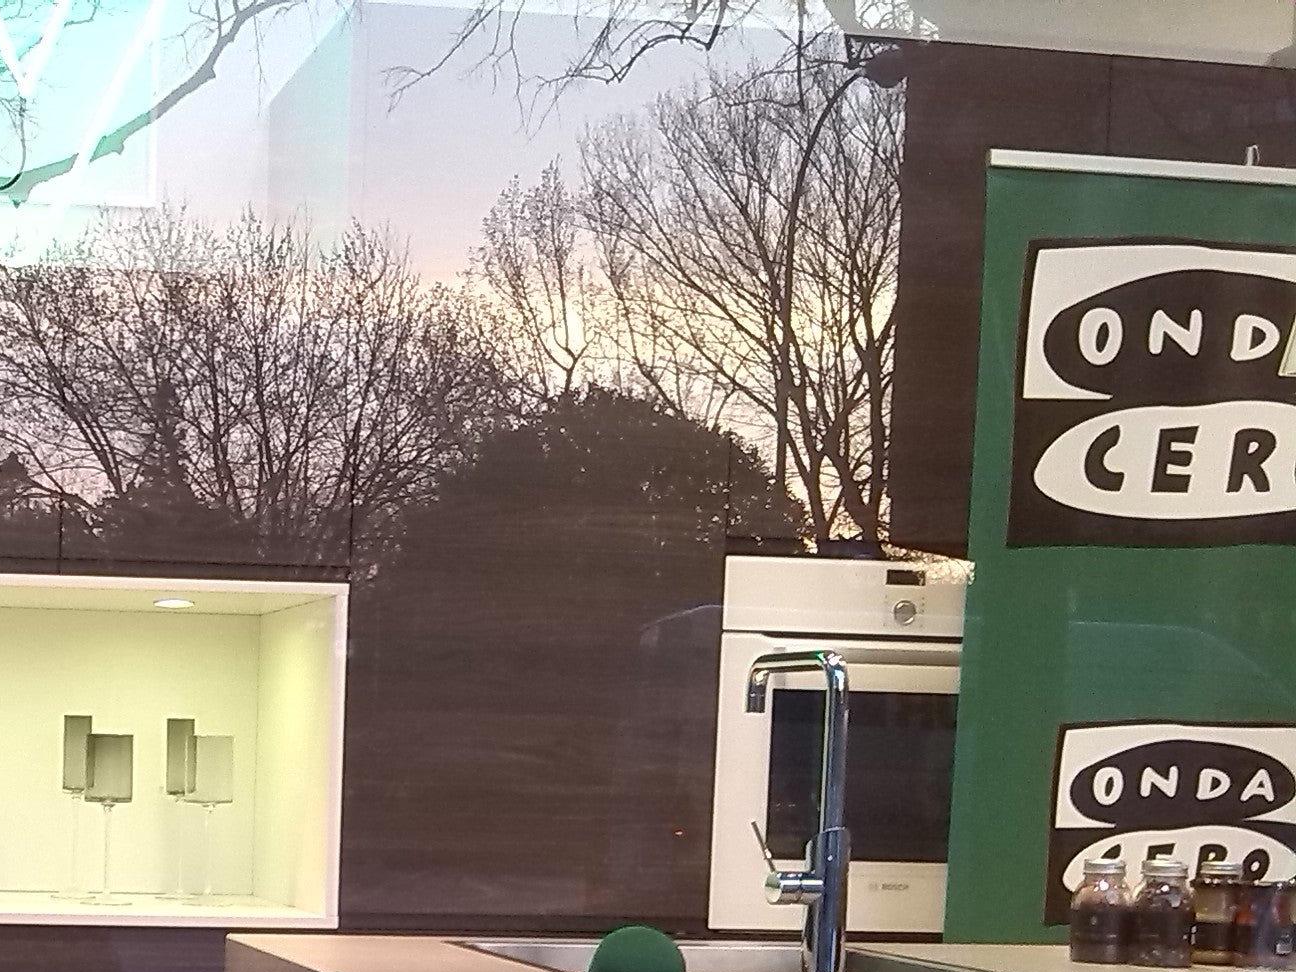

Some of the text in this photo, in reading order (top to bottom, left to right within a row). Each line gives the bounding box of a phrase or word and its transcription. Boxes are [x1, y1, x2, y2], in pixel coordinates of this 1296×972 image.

[1078, 306, 1281, 366] OND
[1083, 423, 1278, 494] CER
[1093, 765, 1275, 806] ONDA
